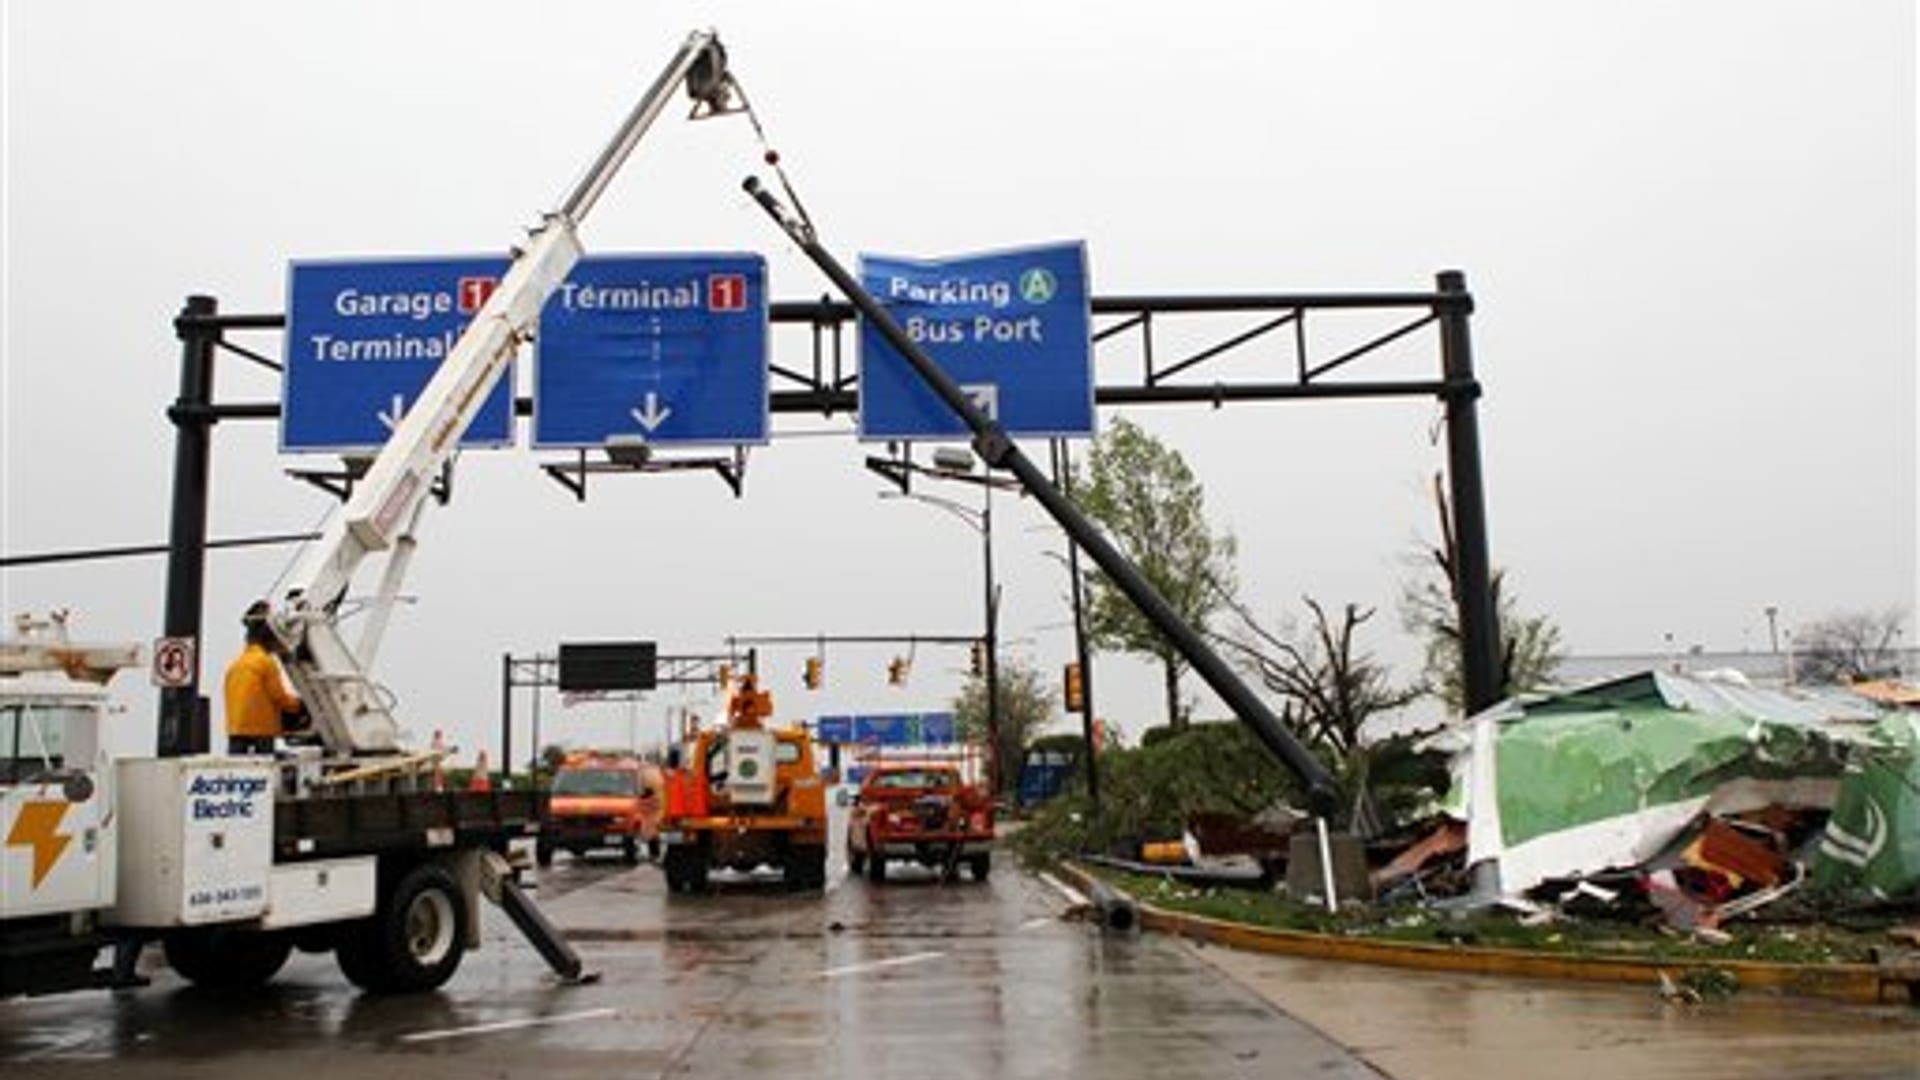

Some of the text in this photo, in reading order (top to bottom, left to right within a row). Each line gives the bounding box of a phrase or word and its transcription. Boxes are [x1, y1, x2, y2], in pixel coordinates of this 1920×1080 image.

[562, 280, 735, 310] Terminal 1
[890, 269, 1052, 308] Parking A
[336, 288, 451, 320] Garage
[906, 316, 1042, 343] Bus Port
[310, 332, 454, 361] Terminal
[194, 798, 252, 819] Electric
